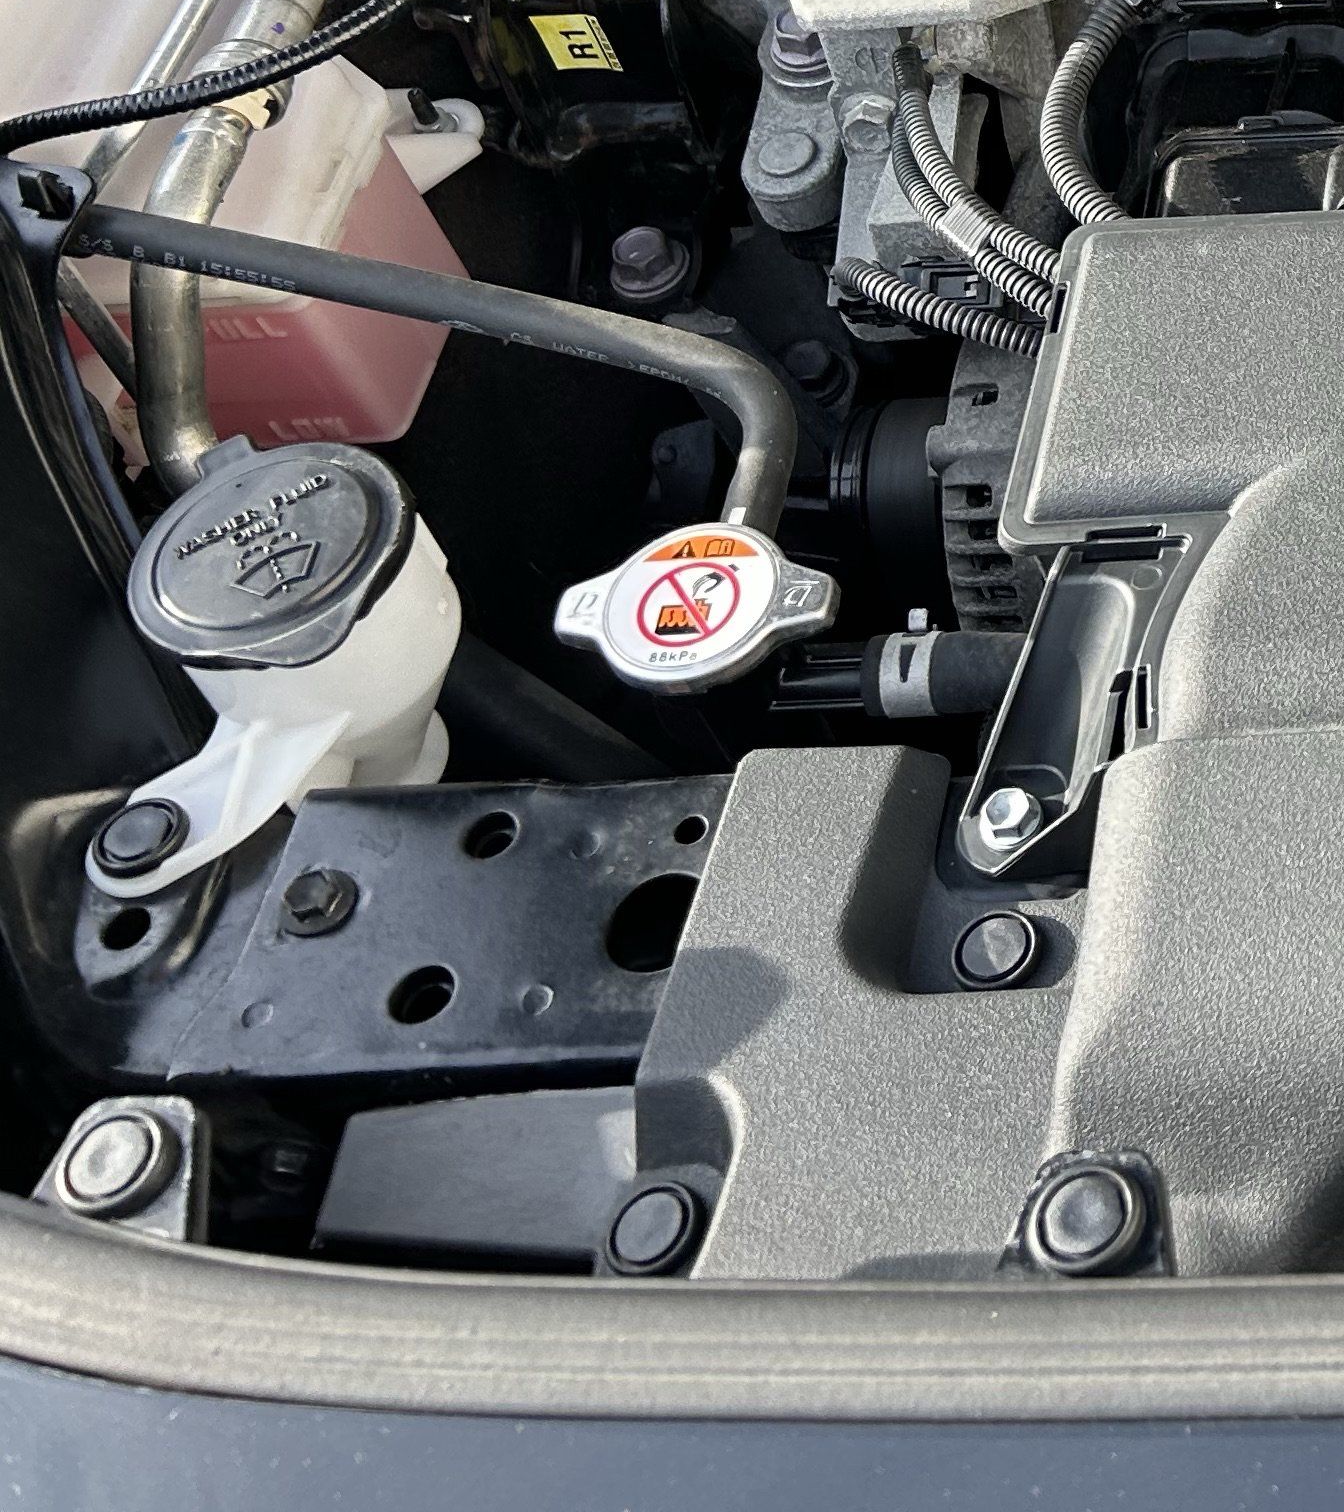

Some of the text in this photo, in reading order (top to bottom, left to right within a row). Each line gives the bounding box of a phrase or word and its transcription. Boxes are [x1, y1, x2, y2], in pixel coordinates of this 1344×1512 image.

[558, 30, 601, 60] R1
[175, 473, 330, 560] WASHER FLUID
[229, 510, 283, 547] ONLY
[649, 649, 697, 663] 88kPa
